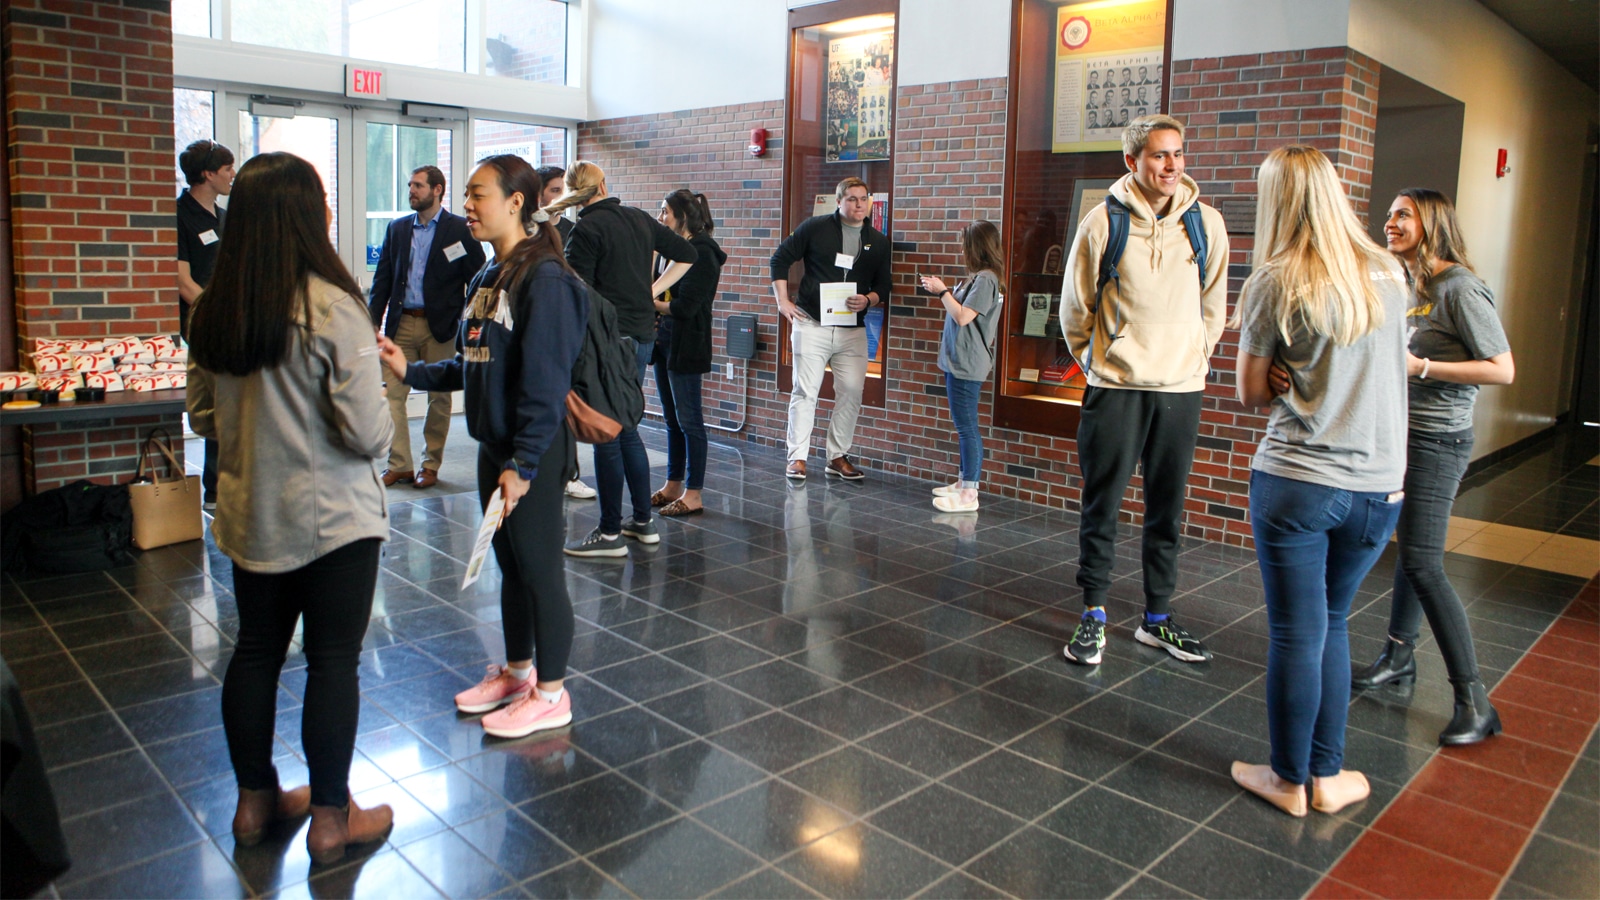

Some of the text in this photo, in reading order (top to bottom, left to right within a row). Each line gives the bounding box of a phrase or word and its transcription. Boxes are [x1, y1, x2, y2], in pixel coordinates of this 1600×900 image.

[1121, 14, 1152, 24] ALPHA
[1087, 60, 1109, 68] BETA
[1116, 57, 1149, 65] ALPHA
[353, 69, 382, 95] EXIT
